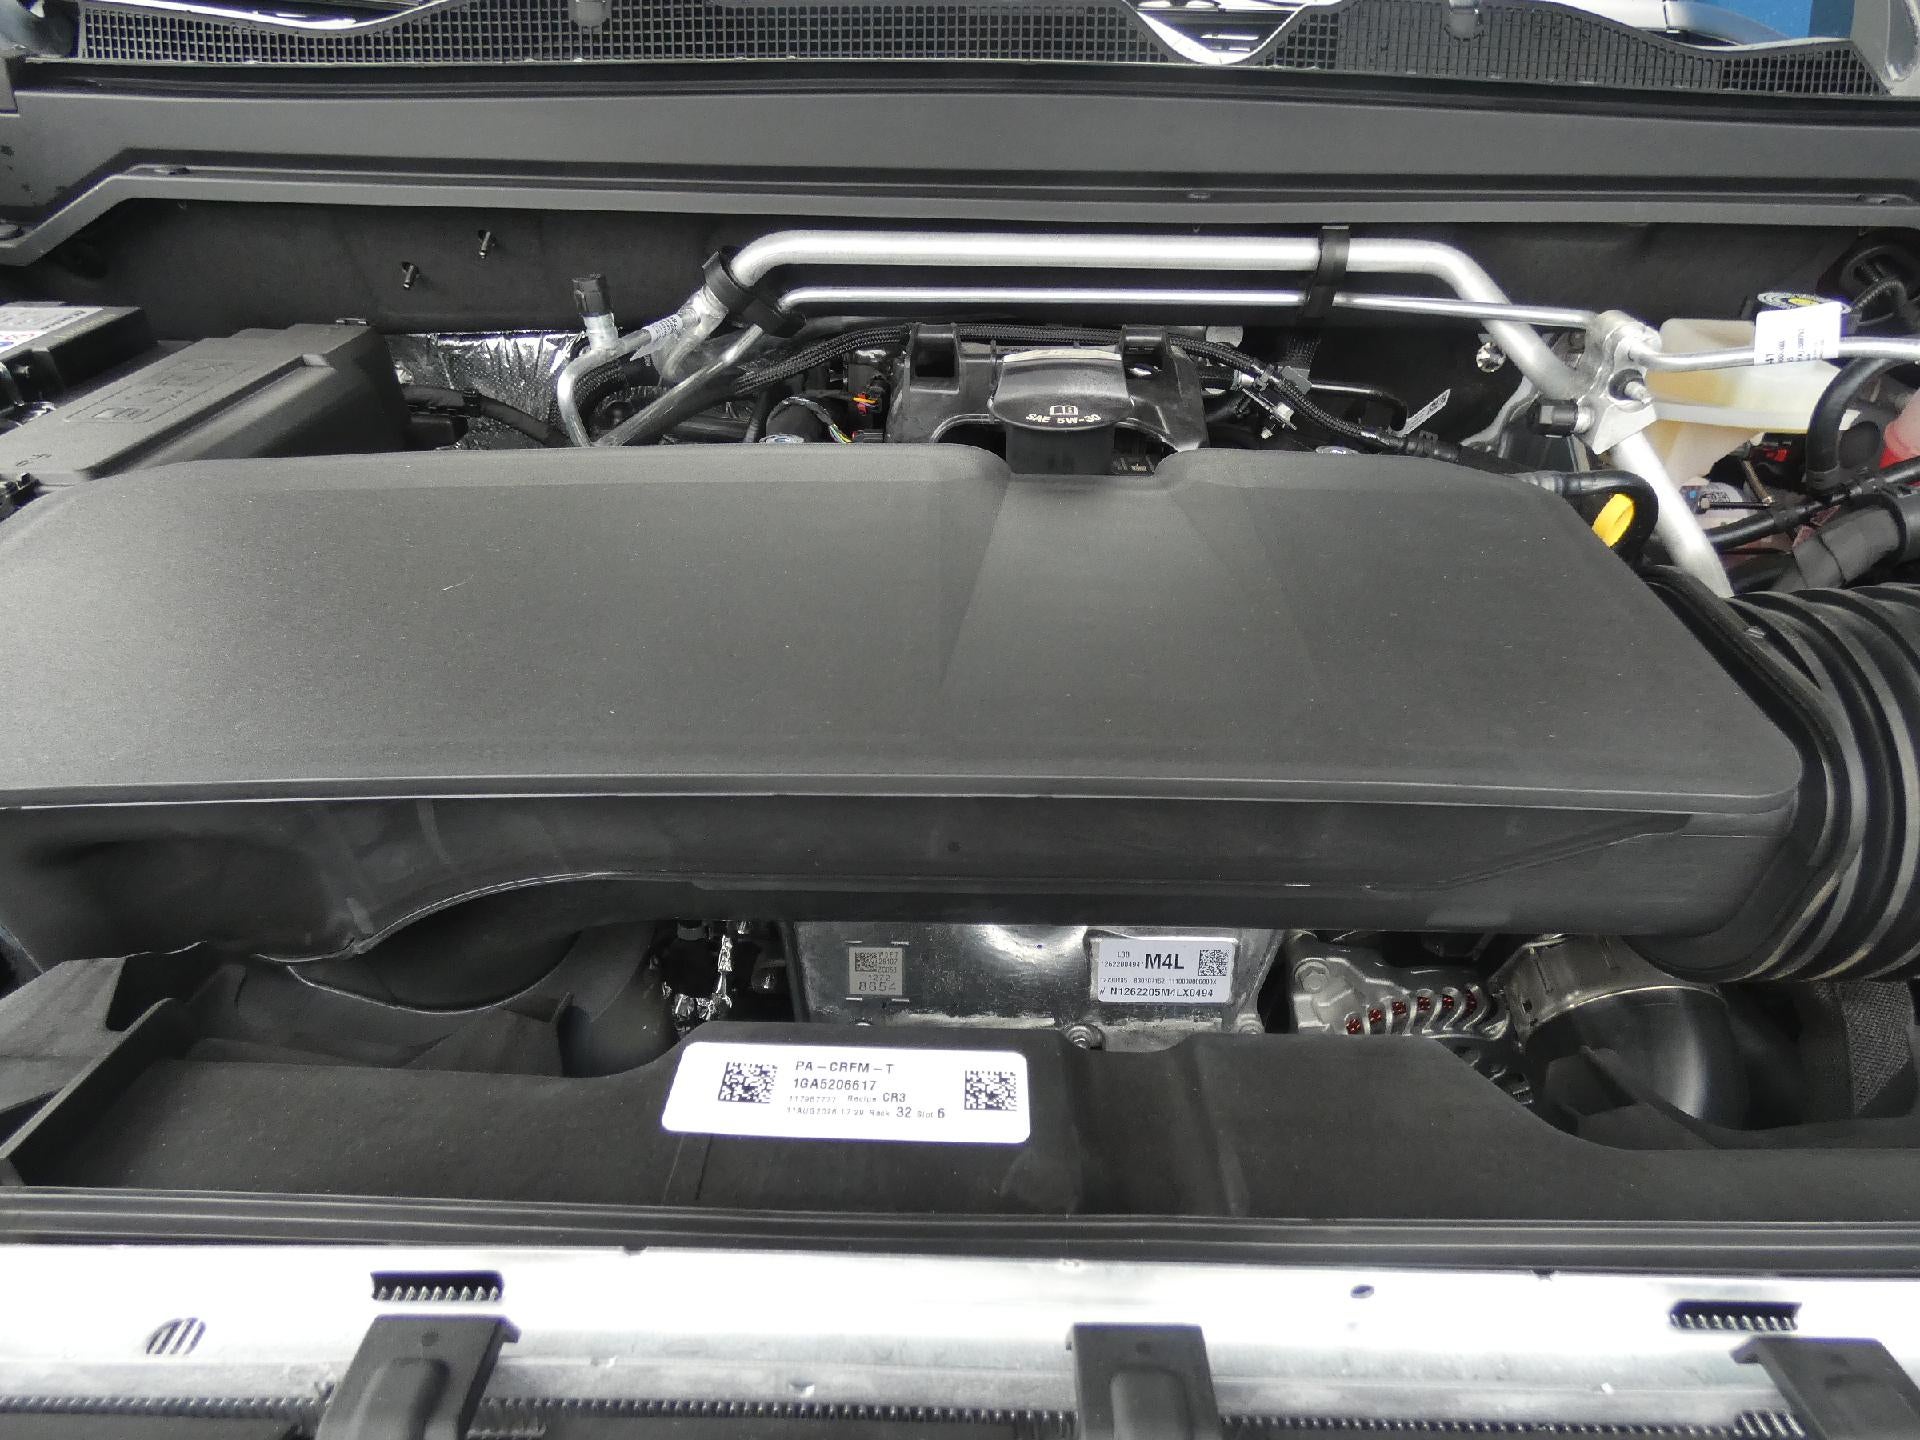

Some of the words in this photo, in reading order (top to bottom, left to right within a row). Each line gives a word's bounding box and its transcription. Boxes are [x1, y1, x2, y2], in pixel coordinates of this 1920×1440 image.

[1026, 413, 1052, 423] SAE
[1056, 413, 1102, 424] 5W-30
[1145, 953, 1185, 970] M4L
[882, 1092, 906, 1103] CR3
[896, 1106, 912, 1118] 32
[937, 1107, 945, 1118] 6
